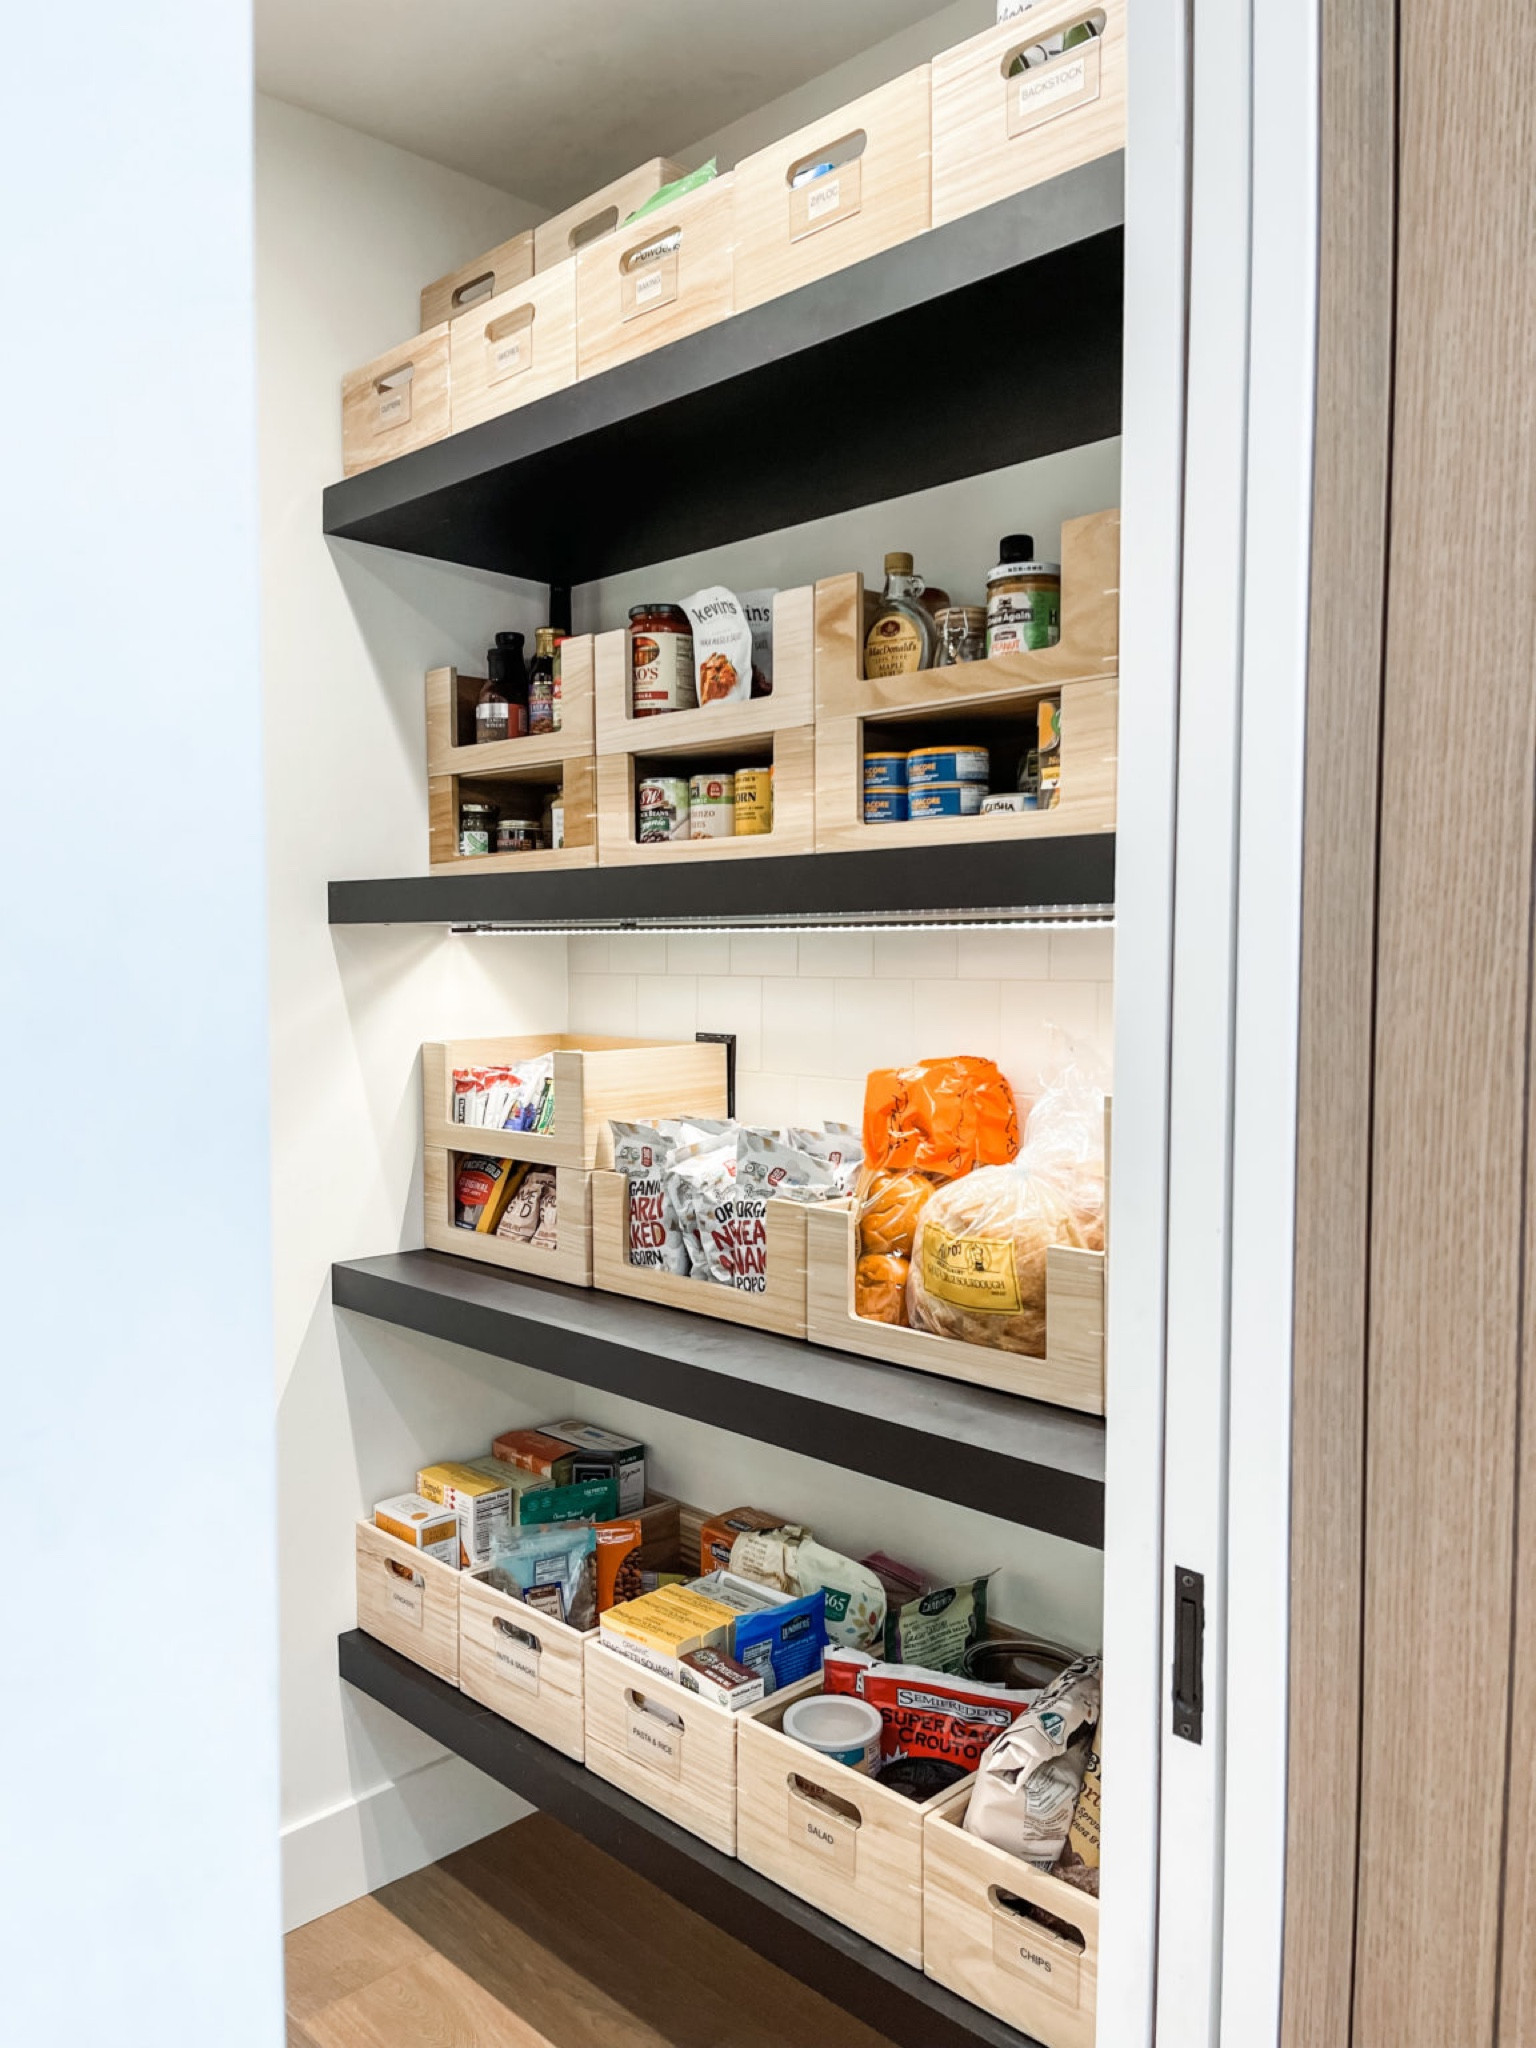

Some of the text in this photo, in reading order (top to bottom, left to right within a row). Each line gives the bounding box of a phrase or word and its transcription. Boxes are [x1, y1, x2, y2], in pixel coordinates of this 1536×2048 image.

[1022, 62, 1082, 100] BACKSTOCK
[811, 184, 838, 207] ZIPLOC
[691, 597, 737, 624] kevin's
[744, 604, 770, 622] in's
[1003, 611, 1032, 622] Again
[630, 1222, 666, 1250] KED
[899, 1690, 1009, 1723] SEMIFREDDI'S
[881, 1707, 944, 1734] SUPER
[633, 1727, 651, 1742] PASTA
[658, 1741, 672, 1755] RICE
[899, 1727, 985, 1758] CROUTO
[807, 1823, 834, 1845] SALAD
[1020, 1947, 1052, 1973] CHIPS
